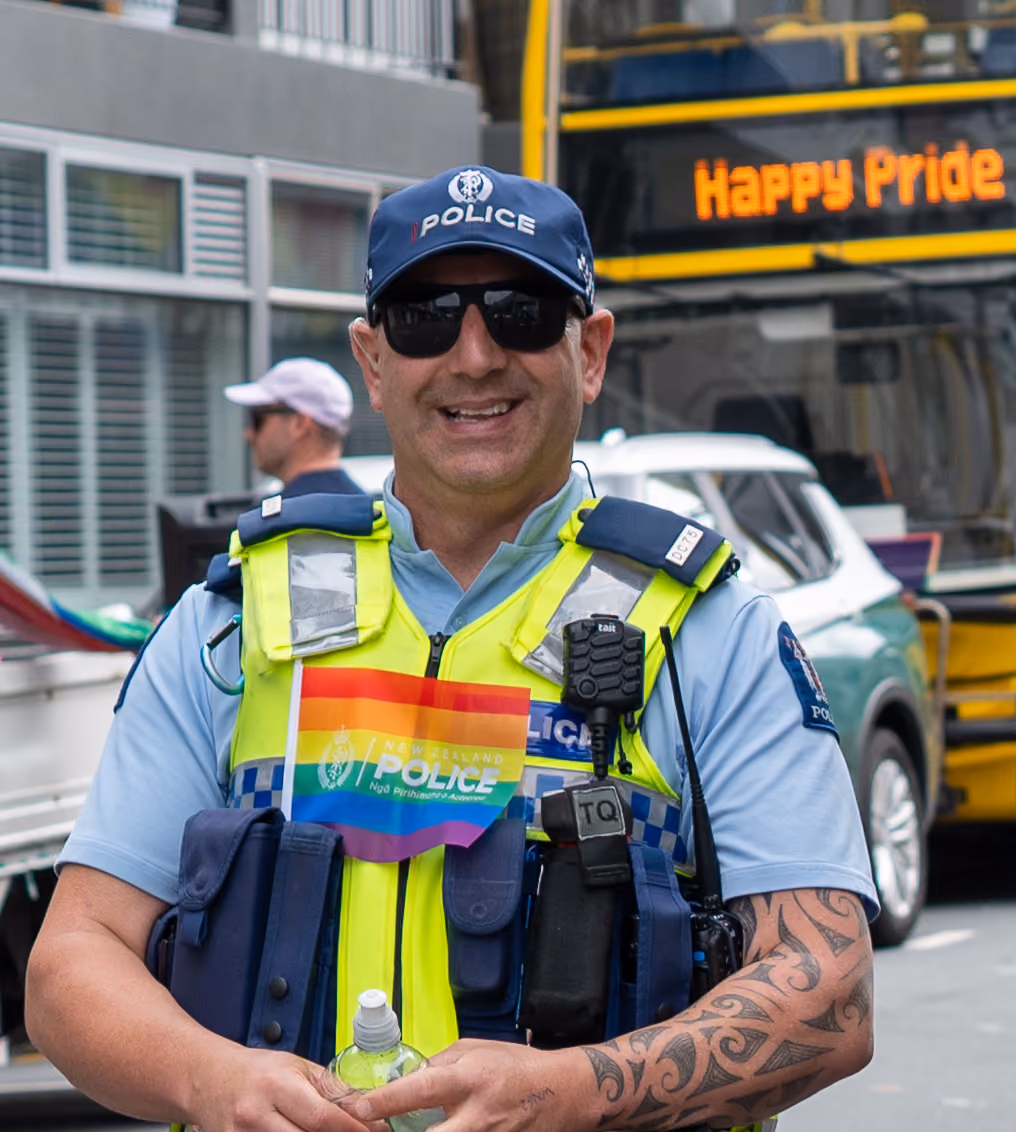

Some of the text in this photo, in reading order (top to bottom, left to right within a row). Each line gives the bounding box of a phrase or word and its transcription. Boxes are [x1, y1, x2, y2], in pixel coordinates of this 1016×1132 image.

[695, 140, 1006, 220] Happy Pride
[420, 204, 536, 239] POLICE
[598, 623, 616, 633] tait
[373, 752, 500, 794] POLICE
[578, 800, 619, 825] TQ
